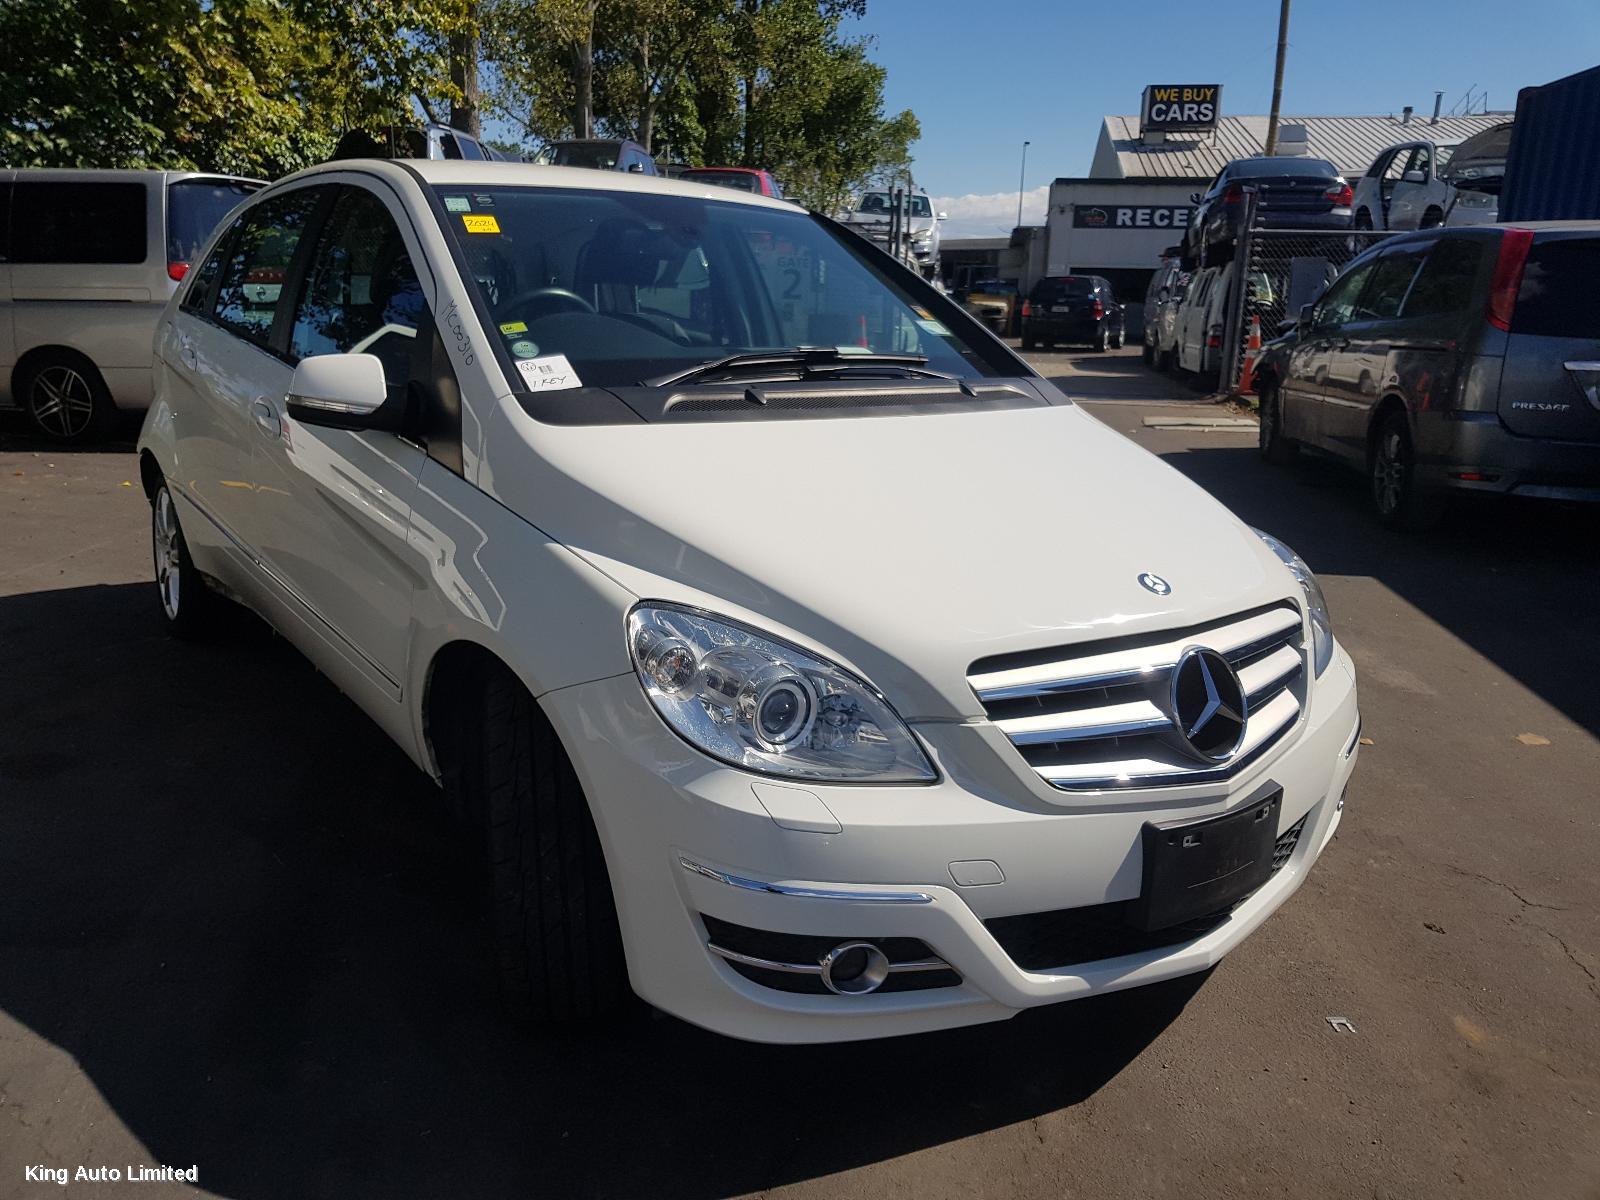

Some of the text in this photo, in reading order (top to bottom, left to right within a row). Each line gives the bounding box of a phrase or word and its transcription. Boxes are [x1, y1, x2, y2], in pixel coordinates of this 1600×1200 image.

[1154, 87, 1215, 102] WE BUY
[1150, 103, 1214, 122] CARS
[777, 257, 809, 268] GATE
[783, 269, 803, 300] 2
[541, 375, 567, 388] KEY
